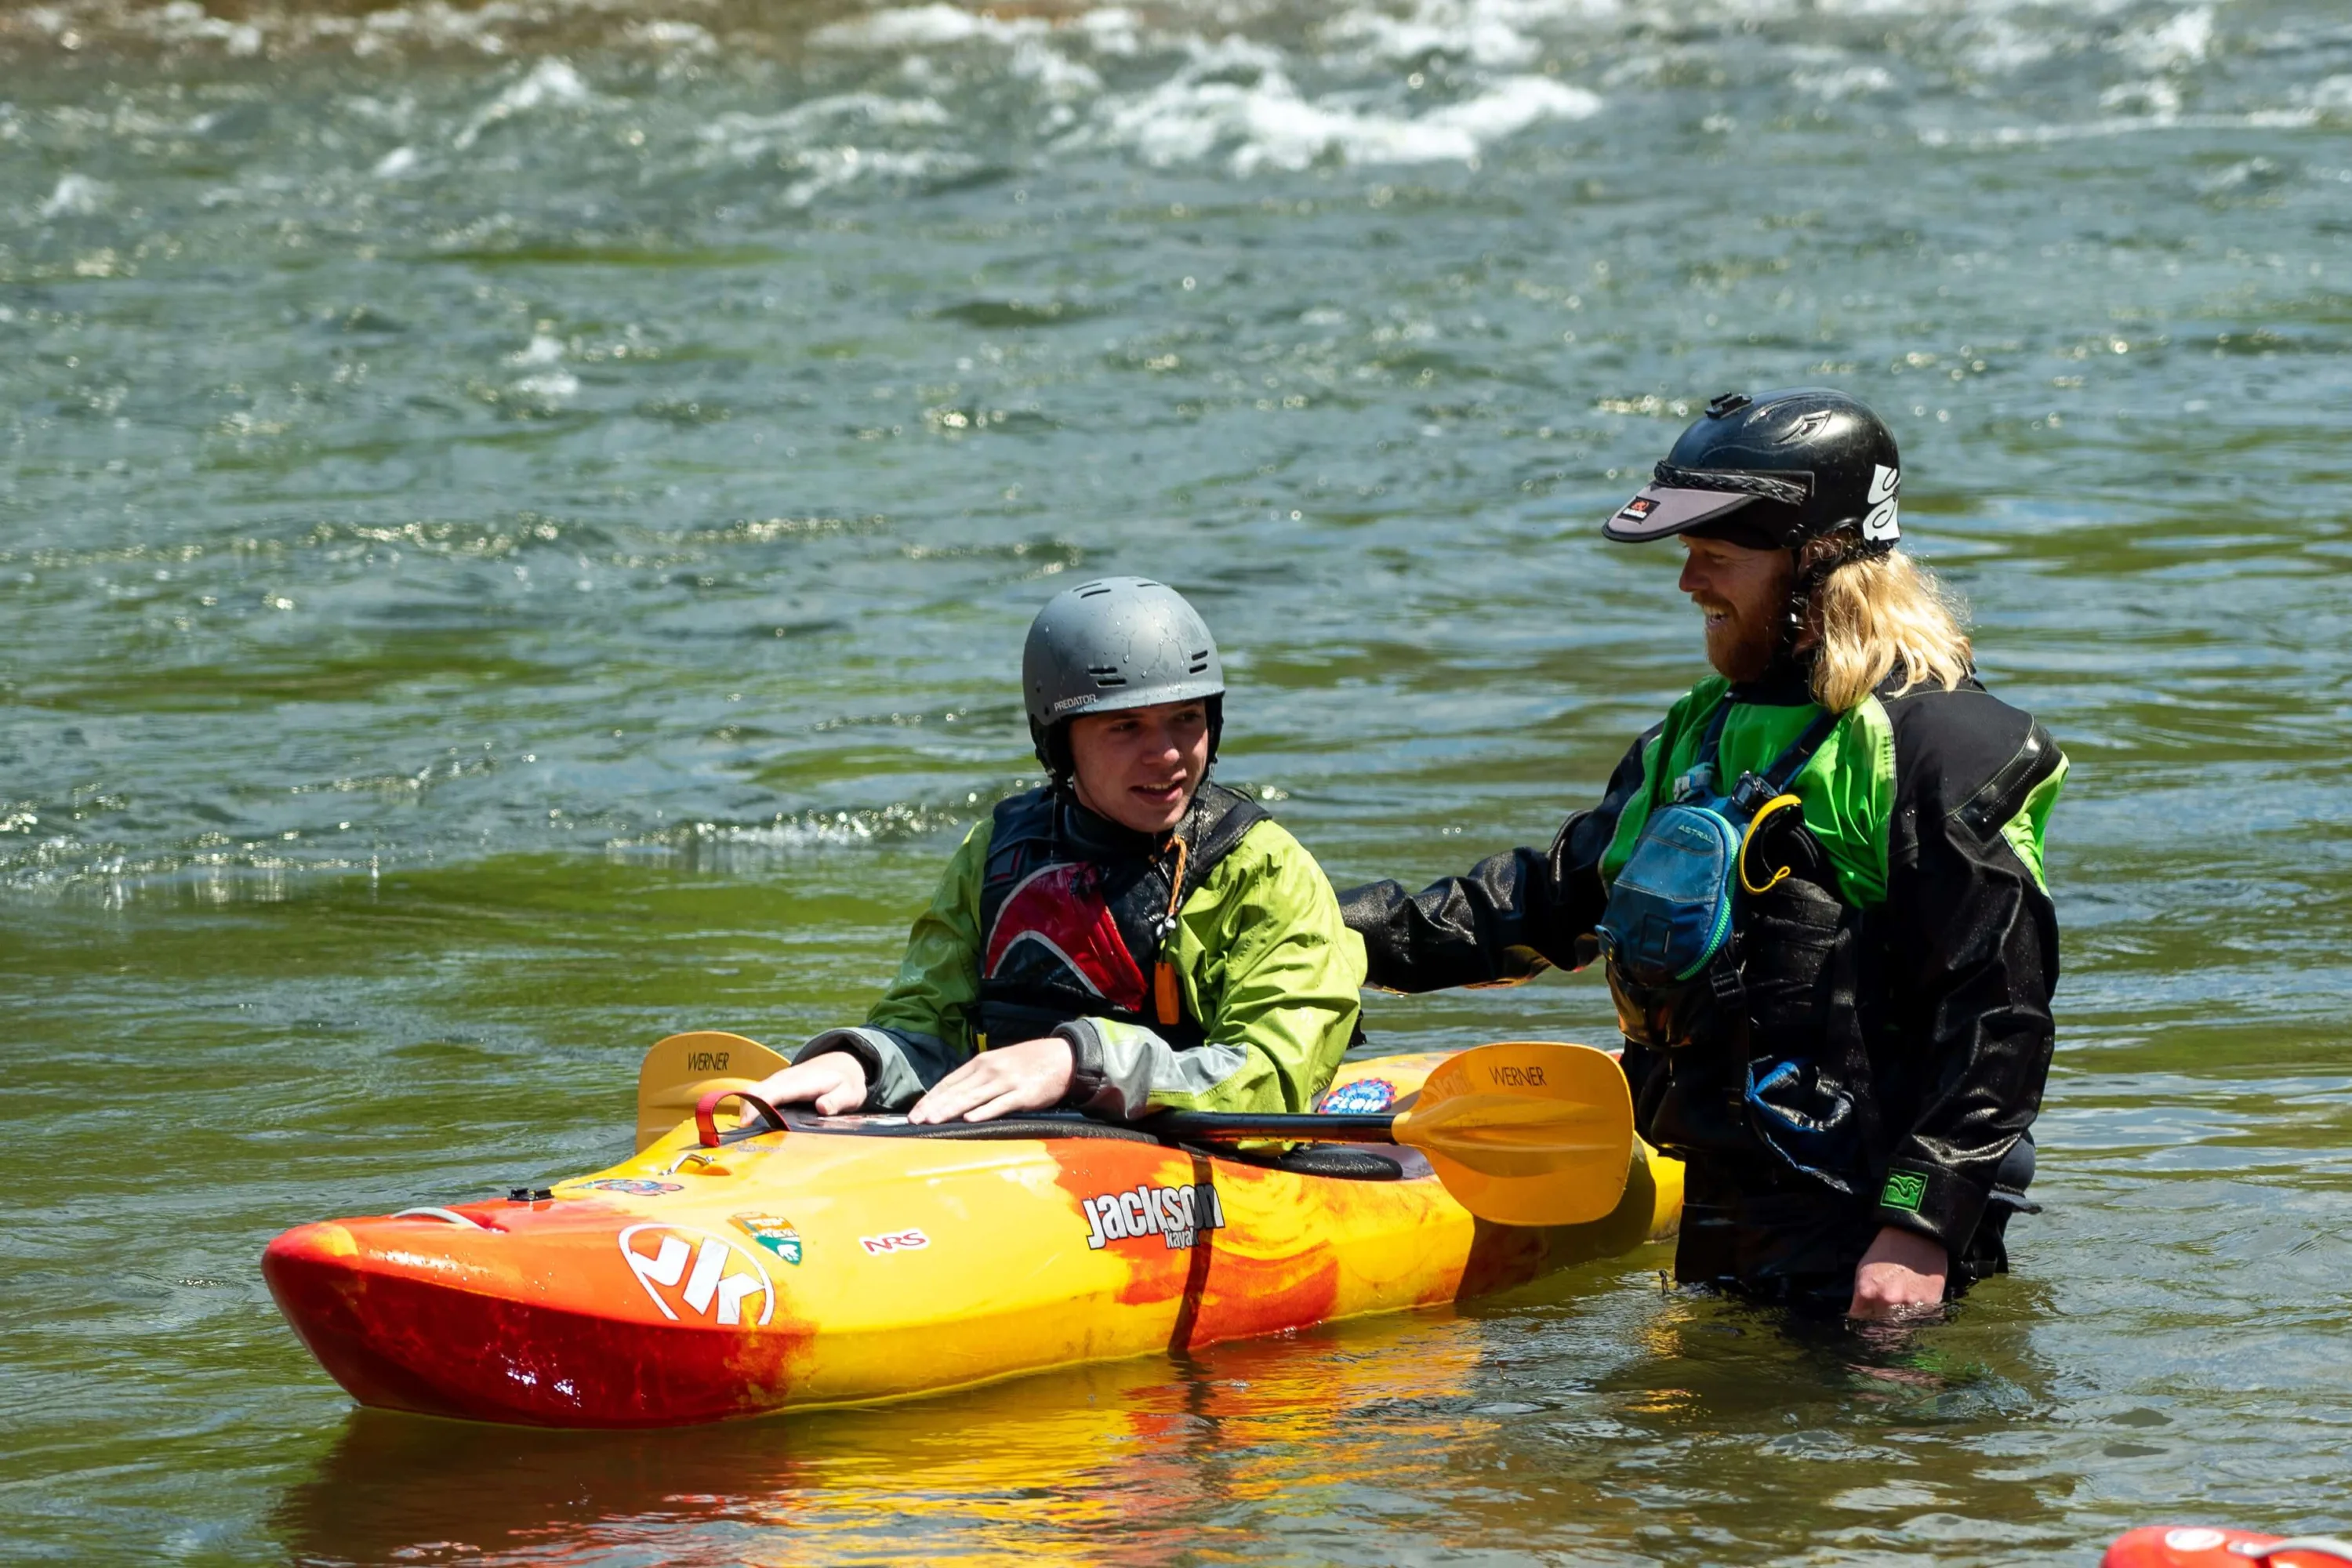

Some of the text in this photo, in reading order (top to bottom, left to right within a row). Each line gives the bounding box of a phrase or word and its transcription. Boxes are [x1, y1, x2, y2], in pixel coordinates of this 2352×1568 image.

[1054, 694, 1097, 712] PREDATOR
[1678, 824, 1715, 844] ASTRAL
[688, 1052, 729, 1071] WERNER
[1489, 1066, 1547, 1086] WERNER
[1327, 1096, 1387, 1111] FLOW
[863, 1232, 927, 1253] NRS
